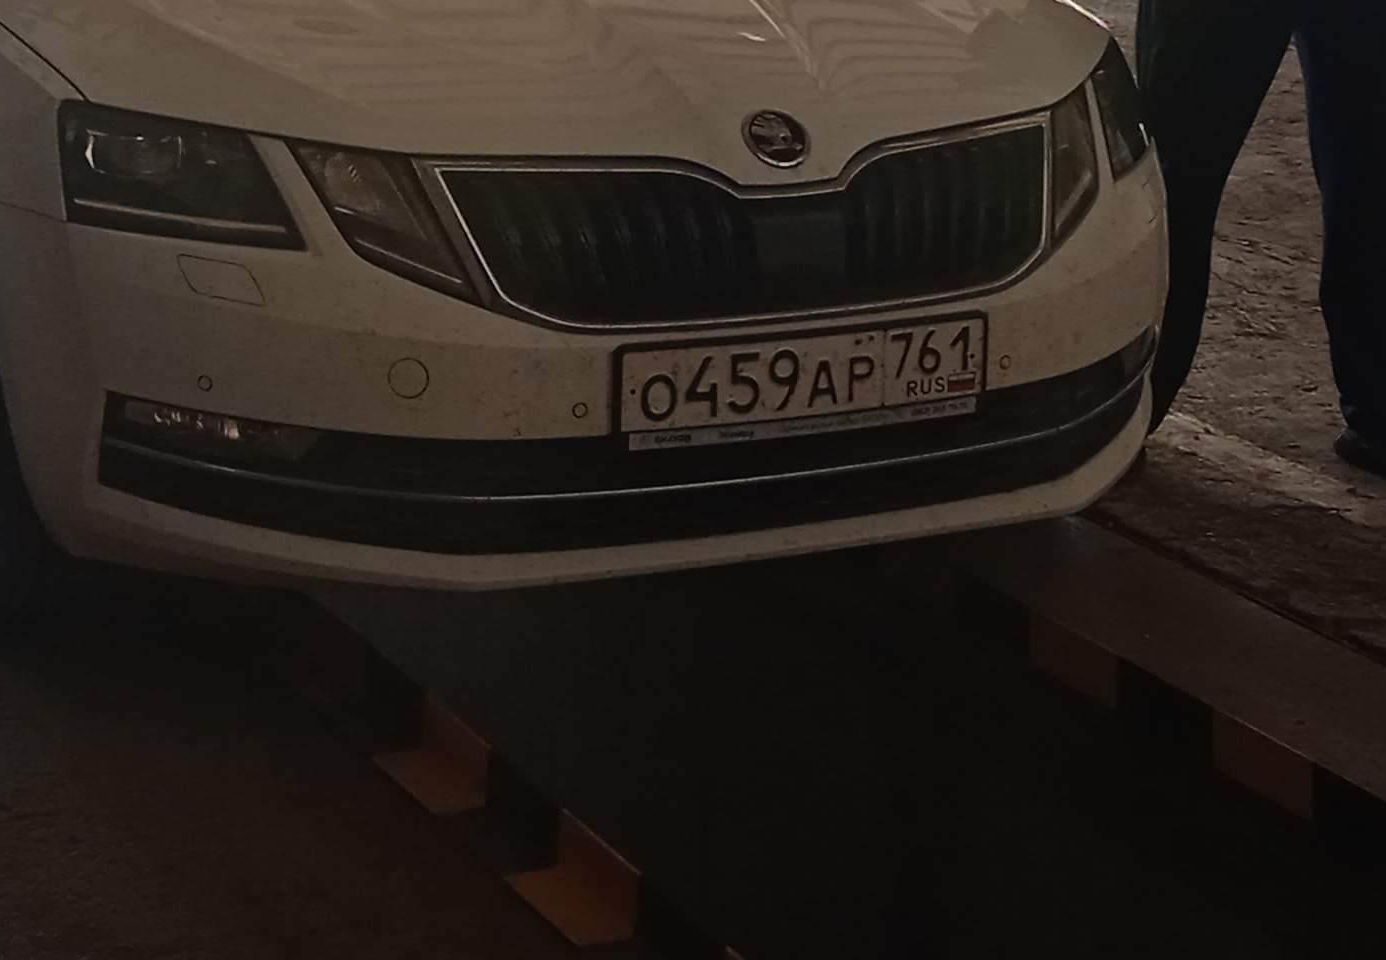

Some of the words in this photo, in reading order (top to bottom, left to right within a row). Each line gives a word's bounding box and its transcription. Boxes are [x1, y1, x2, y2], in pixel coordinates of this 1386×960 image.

[640, 349, 875, 421] О459АР
[891, 326, 971, 379] 761
[906, 377, 945, 397] RUS
